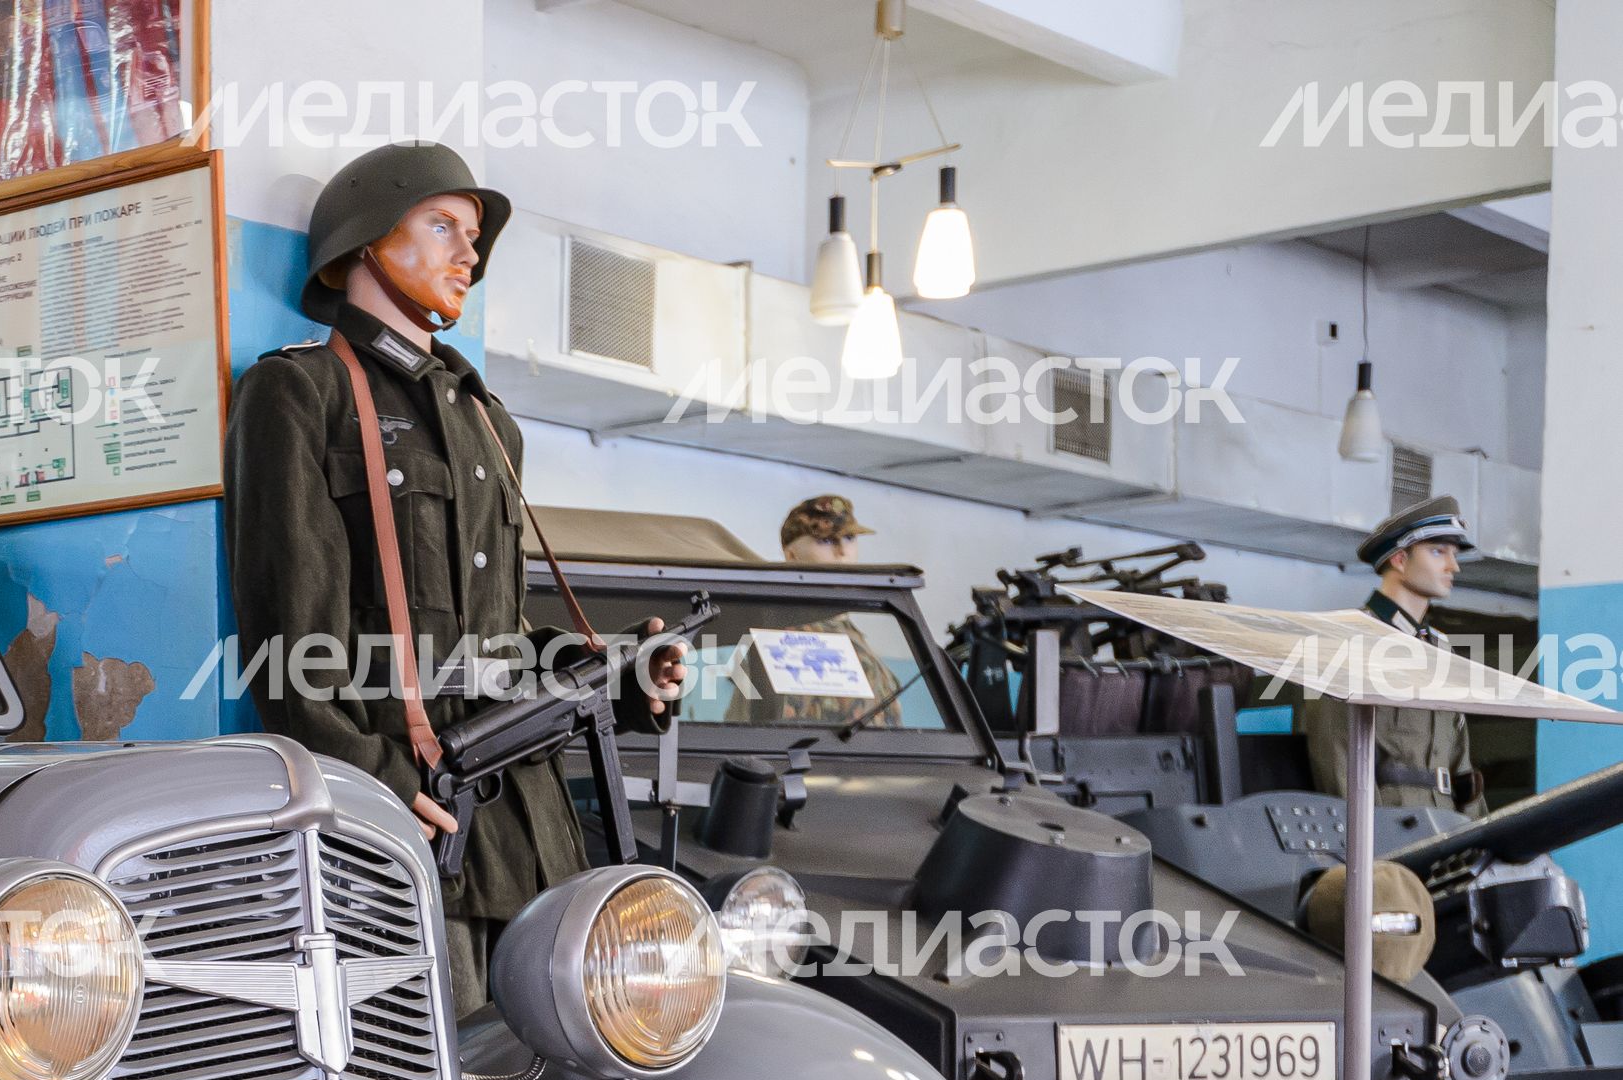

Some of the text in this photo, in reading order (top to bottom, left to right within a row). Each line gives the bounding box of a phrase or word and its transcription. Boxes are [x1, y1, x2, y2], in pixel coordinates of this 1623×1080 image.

[28, 217, 66, 240] ЛЮДЕЙ
[69, 214, 92, 230] ПРИ
[94, 202, 142, 224] ПОЖАРЕ
[17, 254, 23, 262] 2
